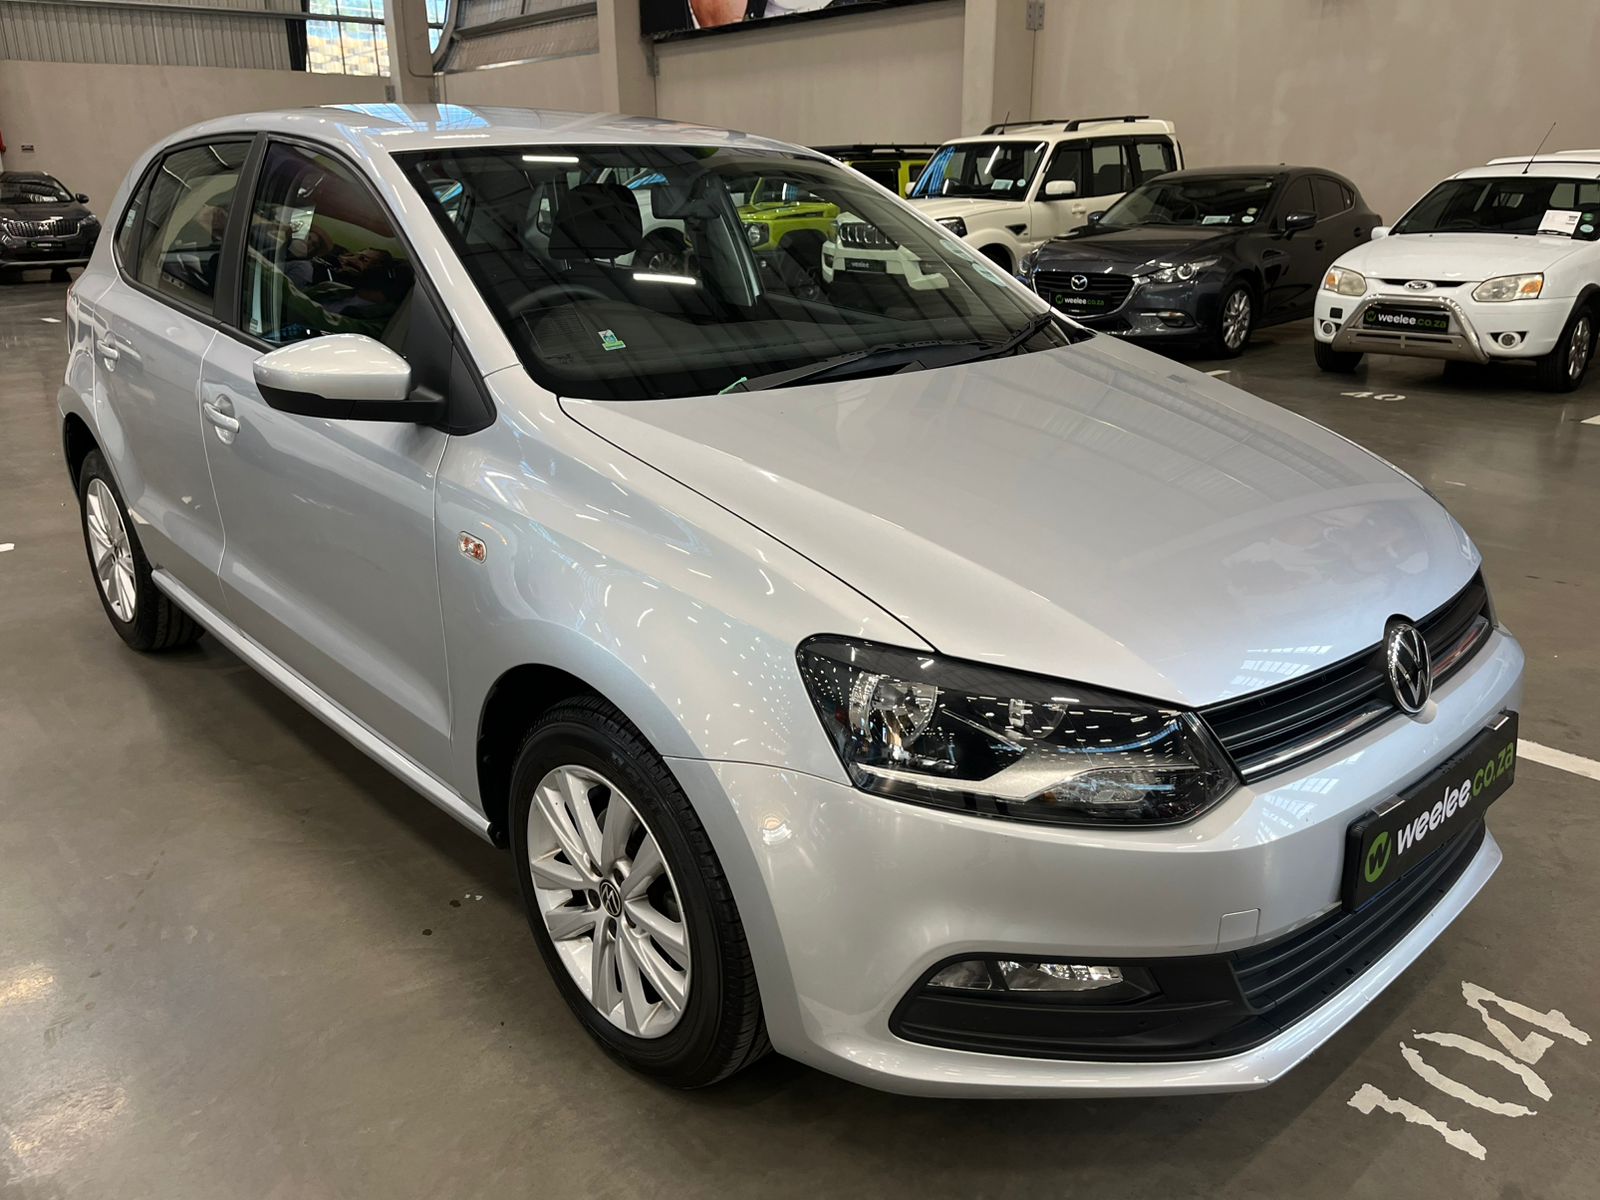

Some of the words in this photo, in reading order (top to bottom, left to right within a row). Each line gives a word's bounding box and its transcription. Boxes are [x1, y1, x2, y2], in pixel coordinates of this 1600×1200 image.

[1378, 313, 1447, 329] weelee.co.za
[1397, 741, 1514, 856] weelee.co.za
[1346, 980, 1593, 1160] 104
